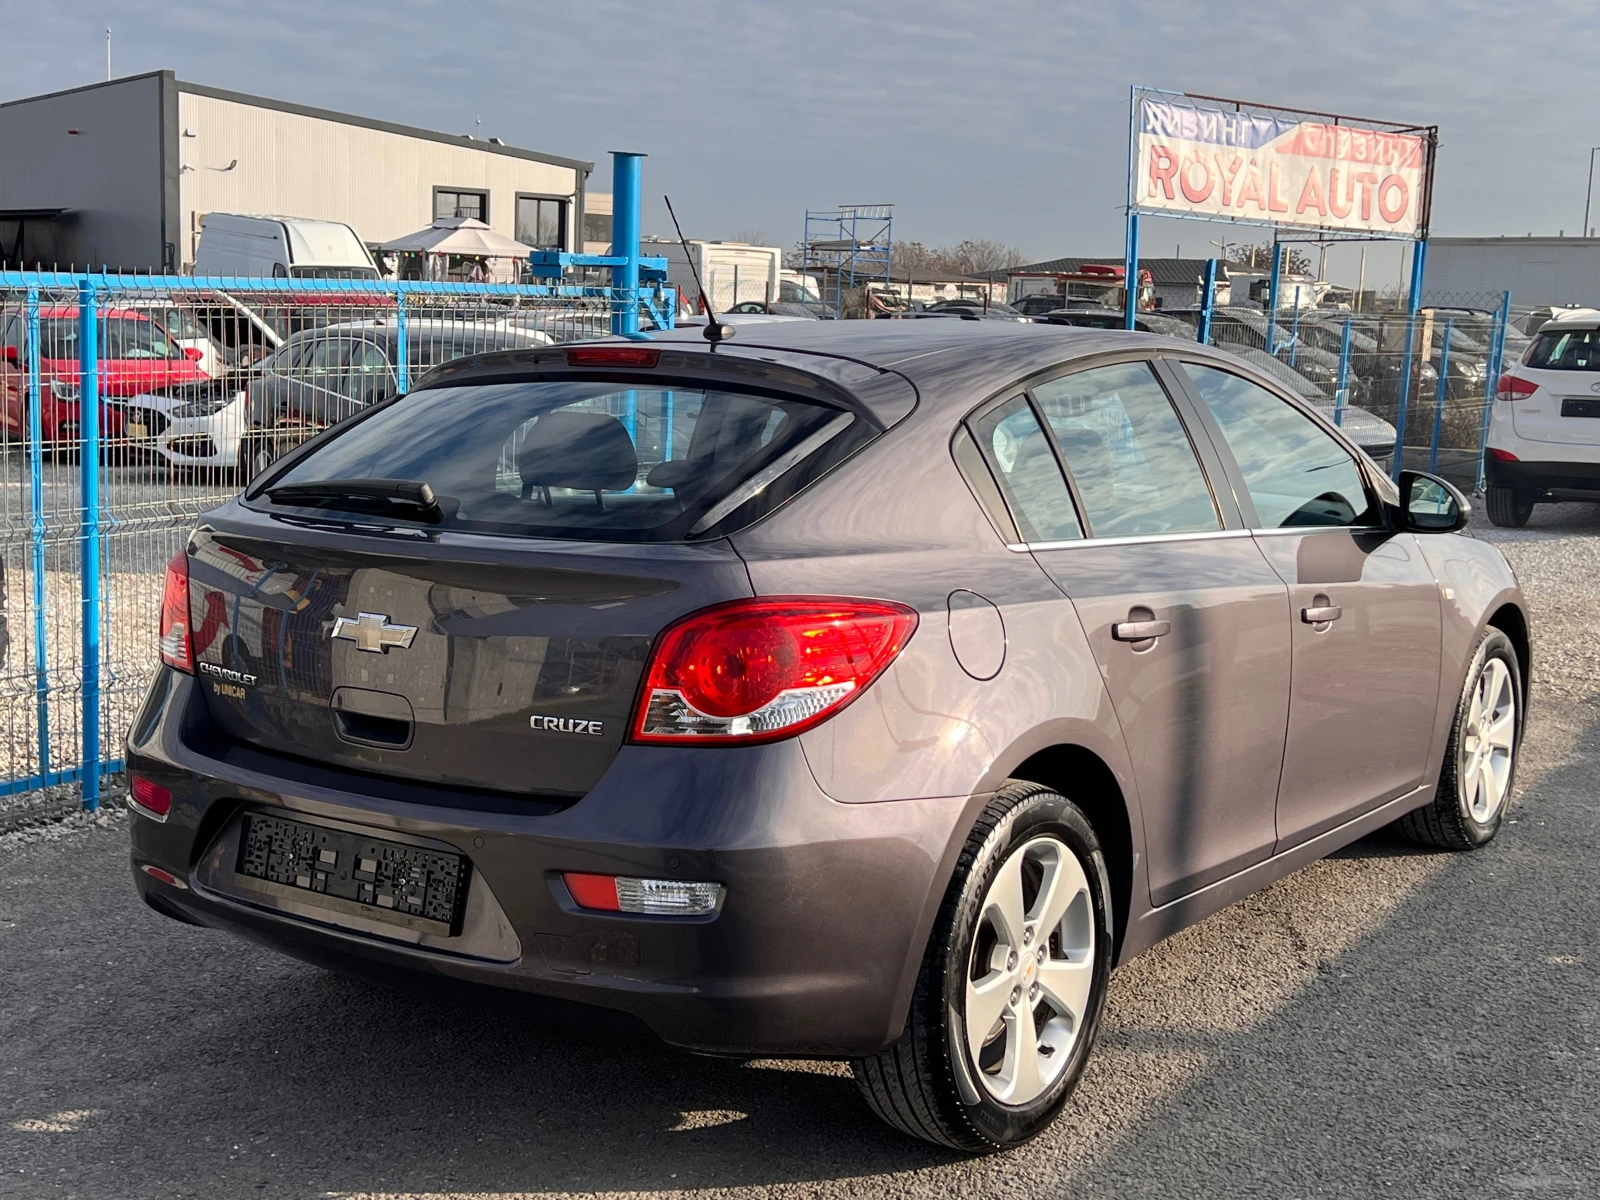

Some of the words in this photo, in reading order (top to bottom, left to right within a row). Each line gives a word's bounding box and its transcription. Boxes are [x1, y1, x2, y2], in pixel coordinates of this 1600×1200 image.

[1148, 144, 1289, 213] ROYAL
[1296, 163, 1409, 223] AUTO
[200, 661, 258, 686] CHEVROLET
[213, 681, 221, 696] by
[221, 683, 246, 700] UNICAR
[529, 715, 603, 735] CRUZE
